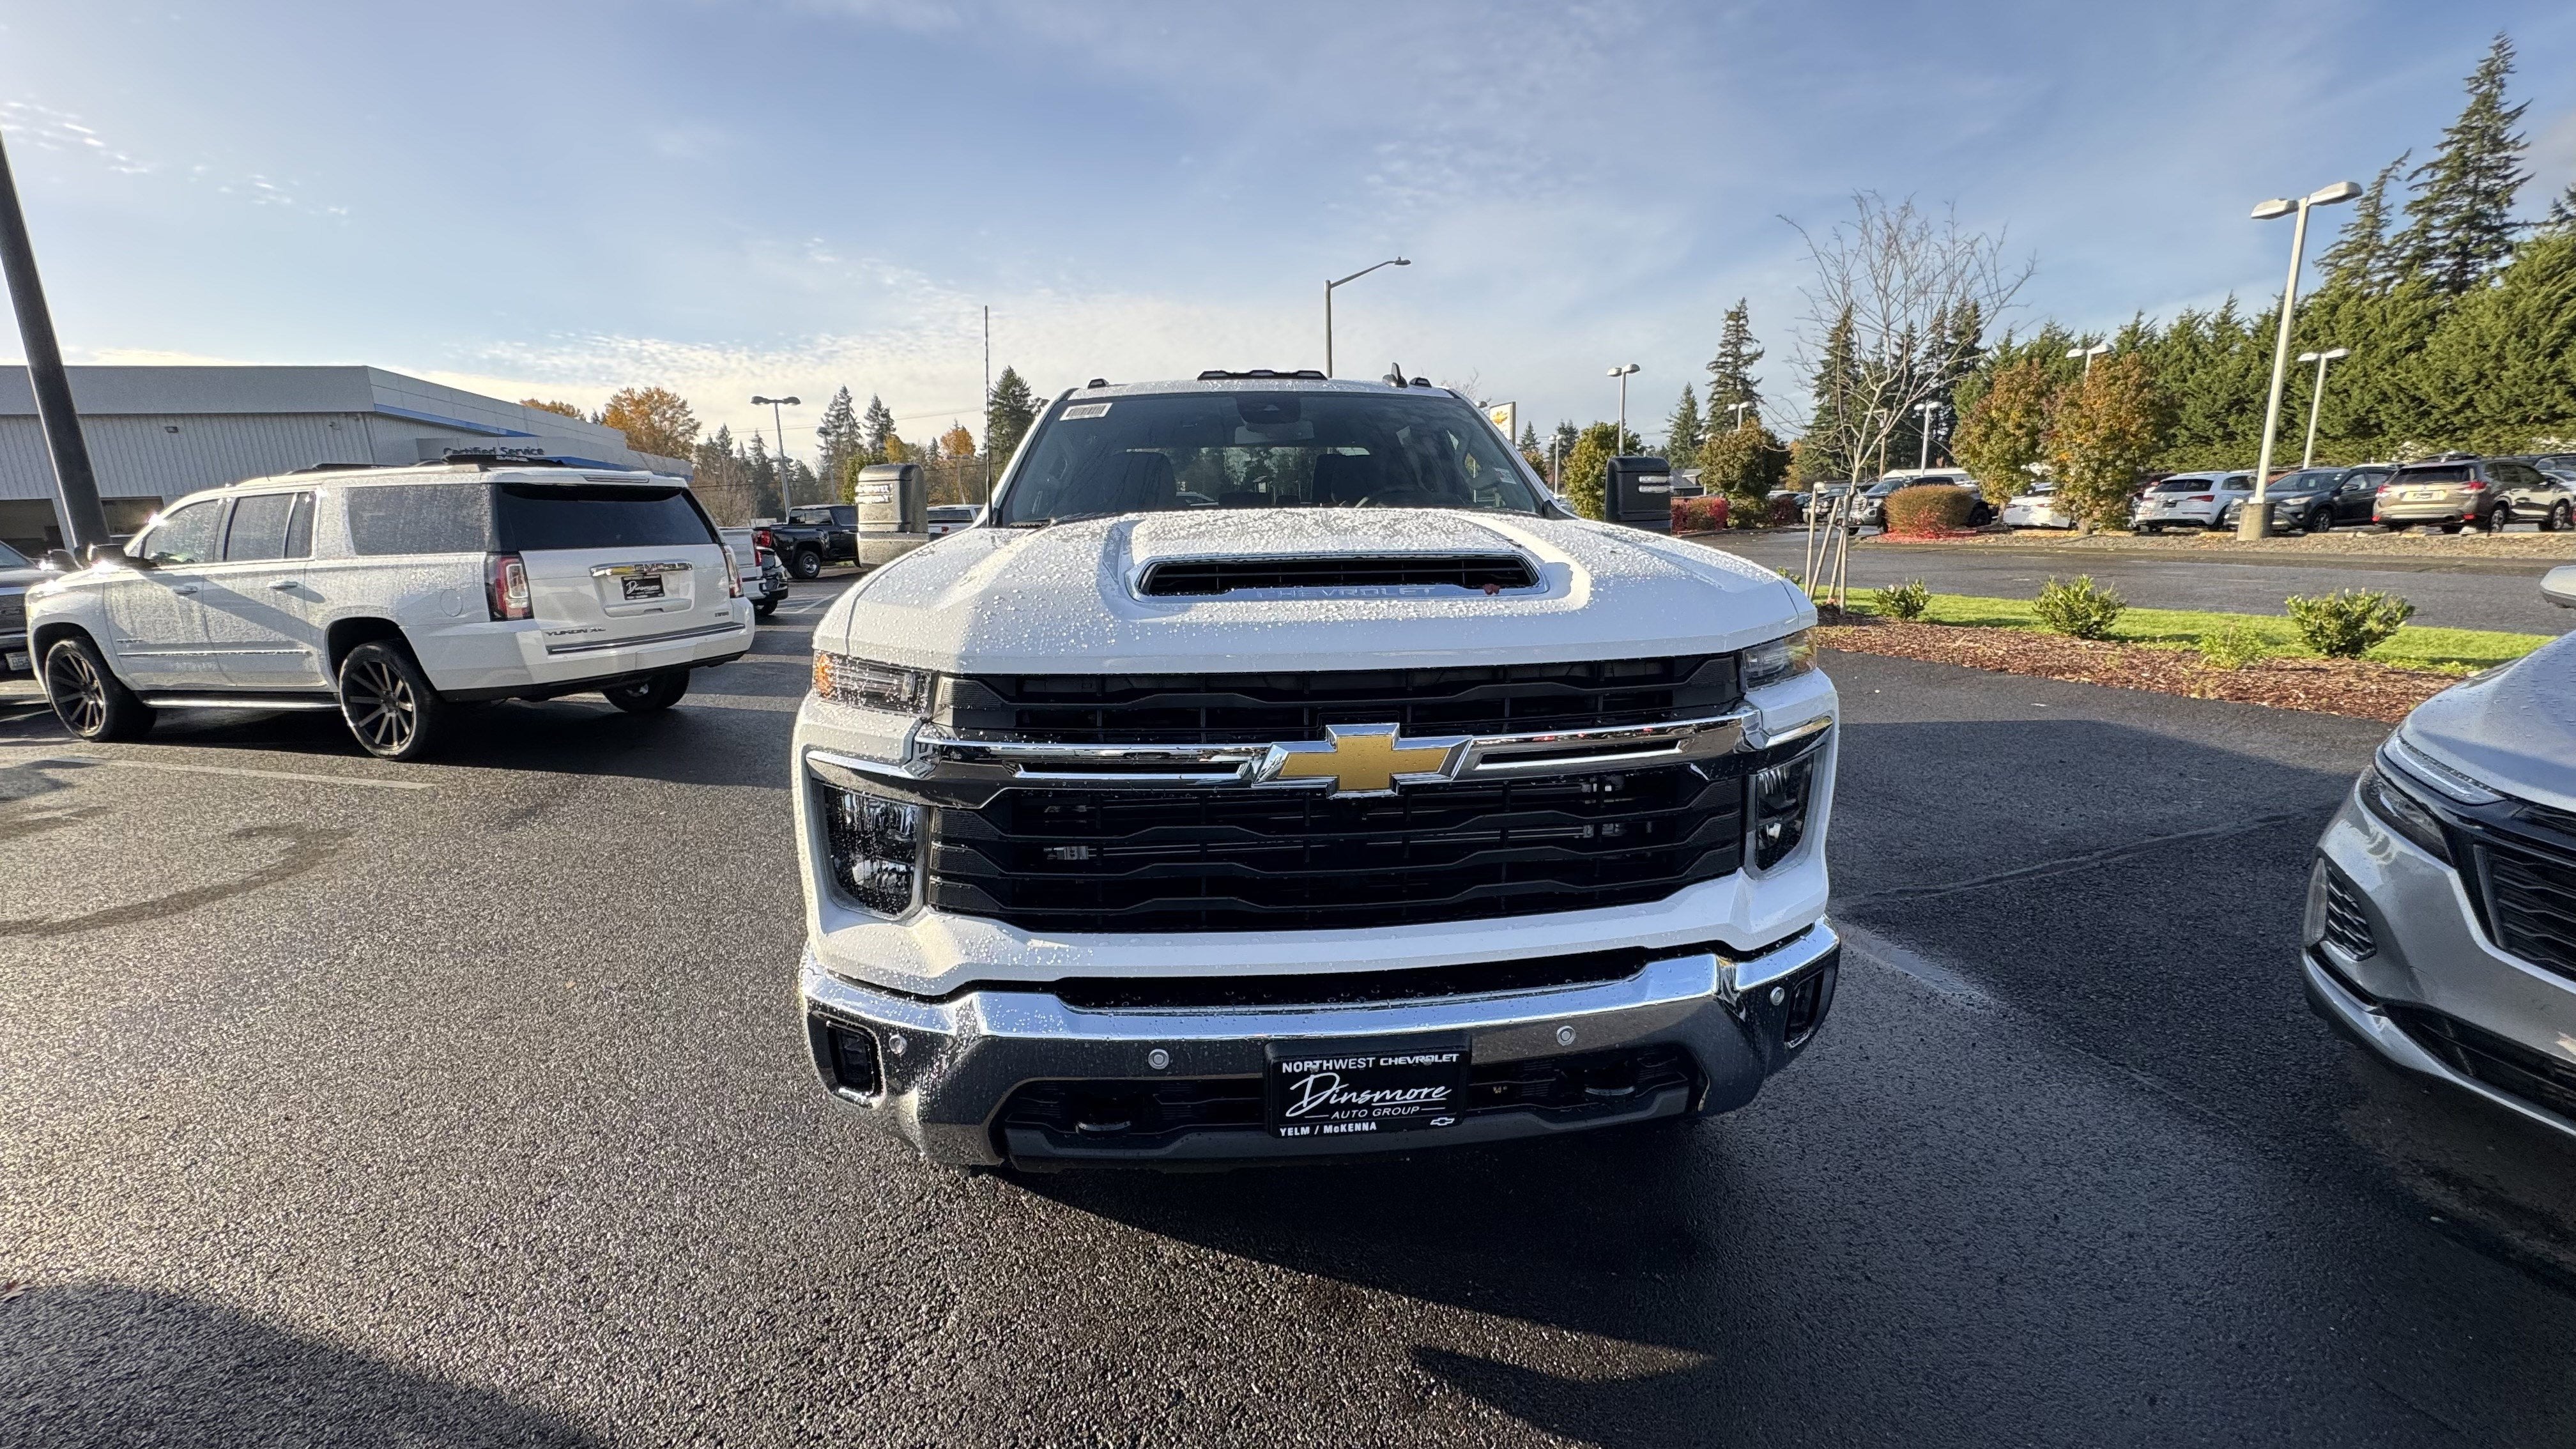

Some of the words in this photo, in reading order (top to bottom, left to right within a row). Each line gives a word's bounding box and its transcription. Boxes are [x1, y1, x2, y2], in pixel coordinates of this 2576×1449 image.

[500, 447, 544, 456] Service
[1282, 1057, 1376, 1073] NORTHWEST
[1380, 1054, 1459, 1066] CHEVROLET
[1285, 1072, 1452, 1117] Dinsmore
[1331, 1109, 1368, 1119] AUTO
[1372, 1106, 1420, 1117] GROUP
[1280, 1126, 1310, 1137] YELM
